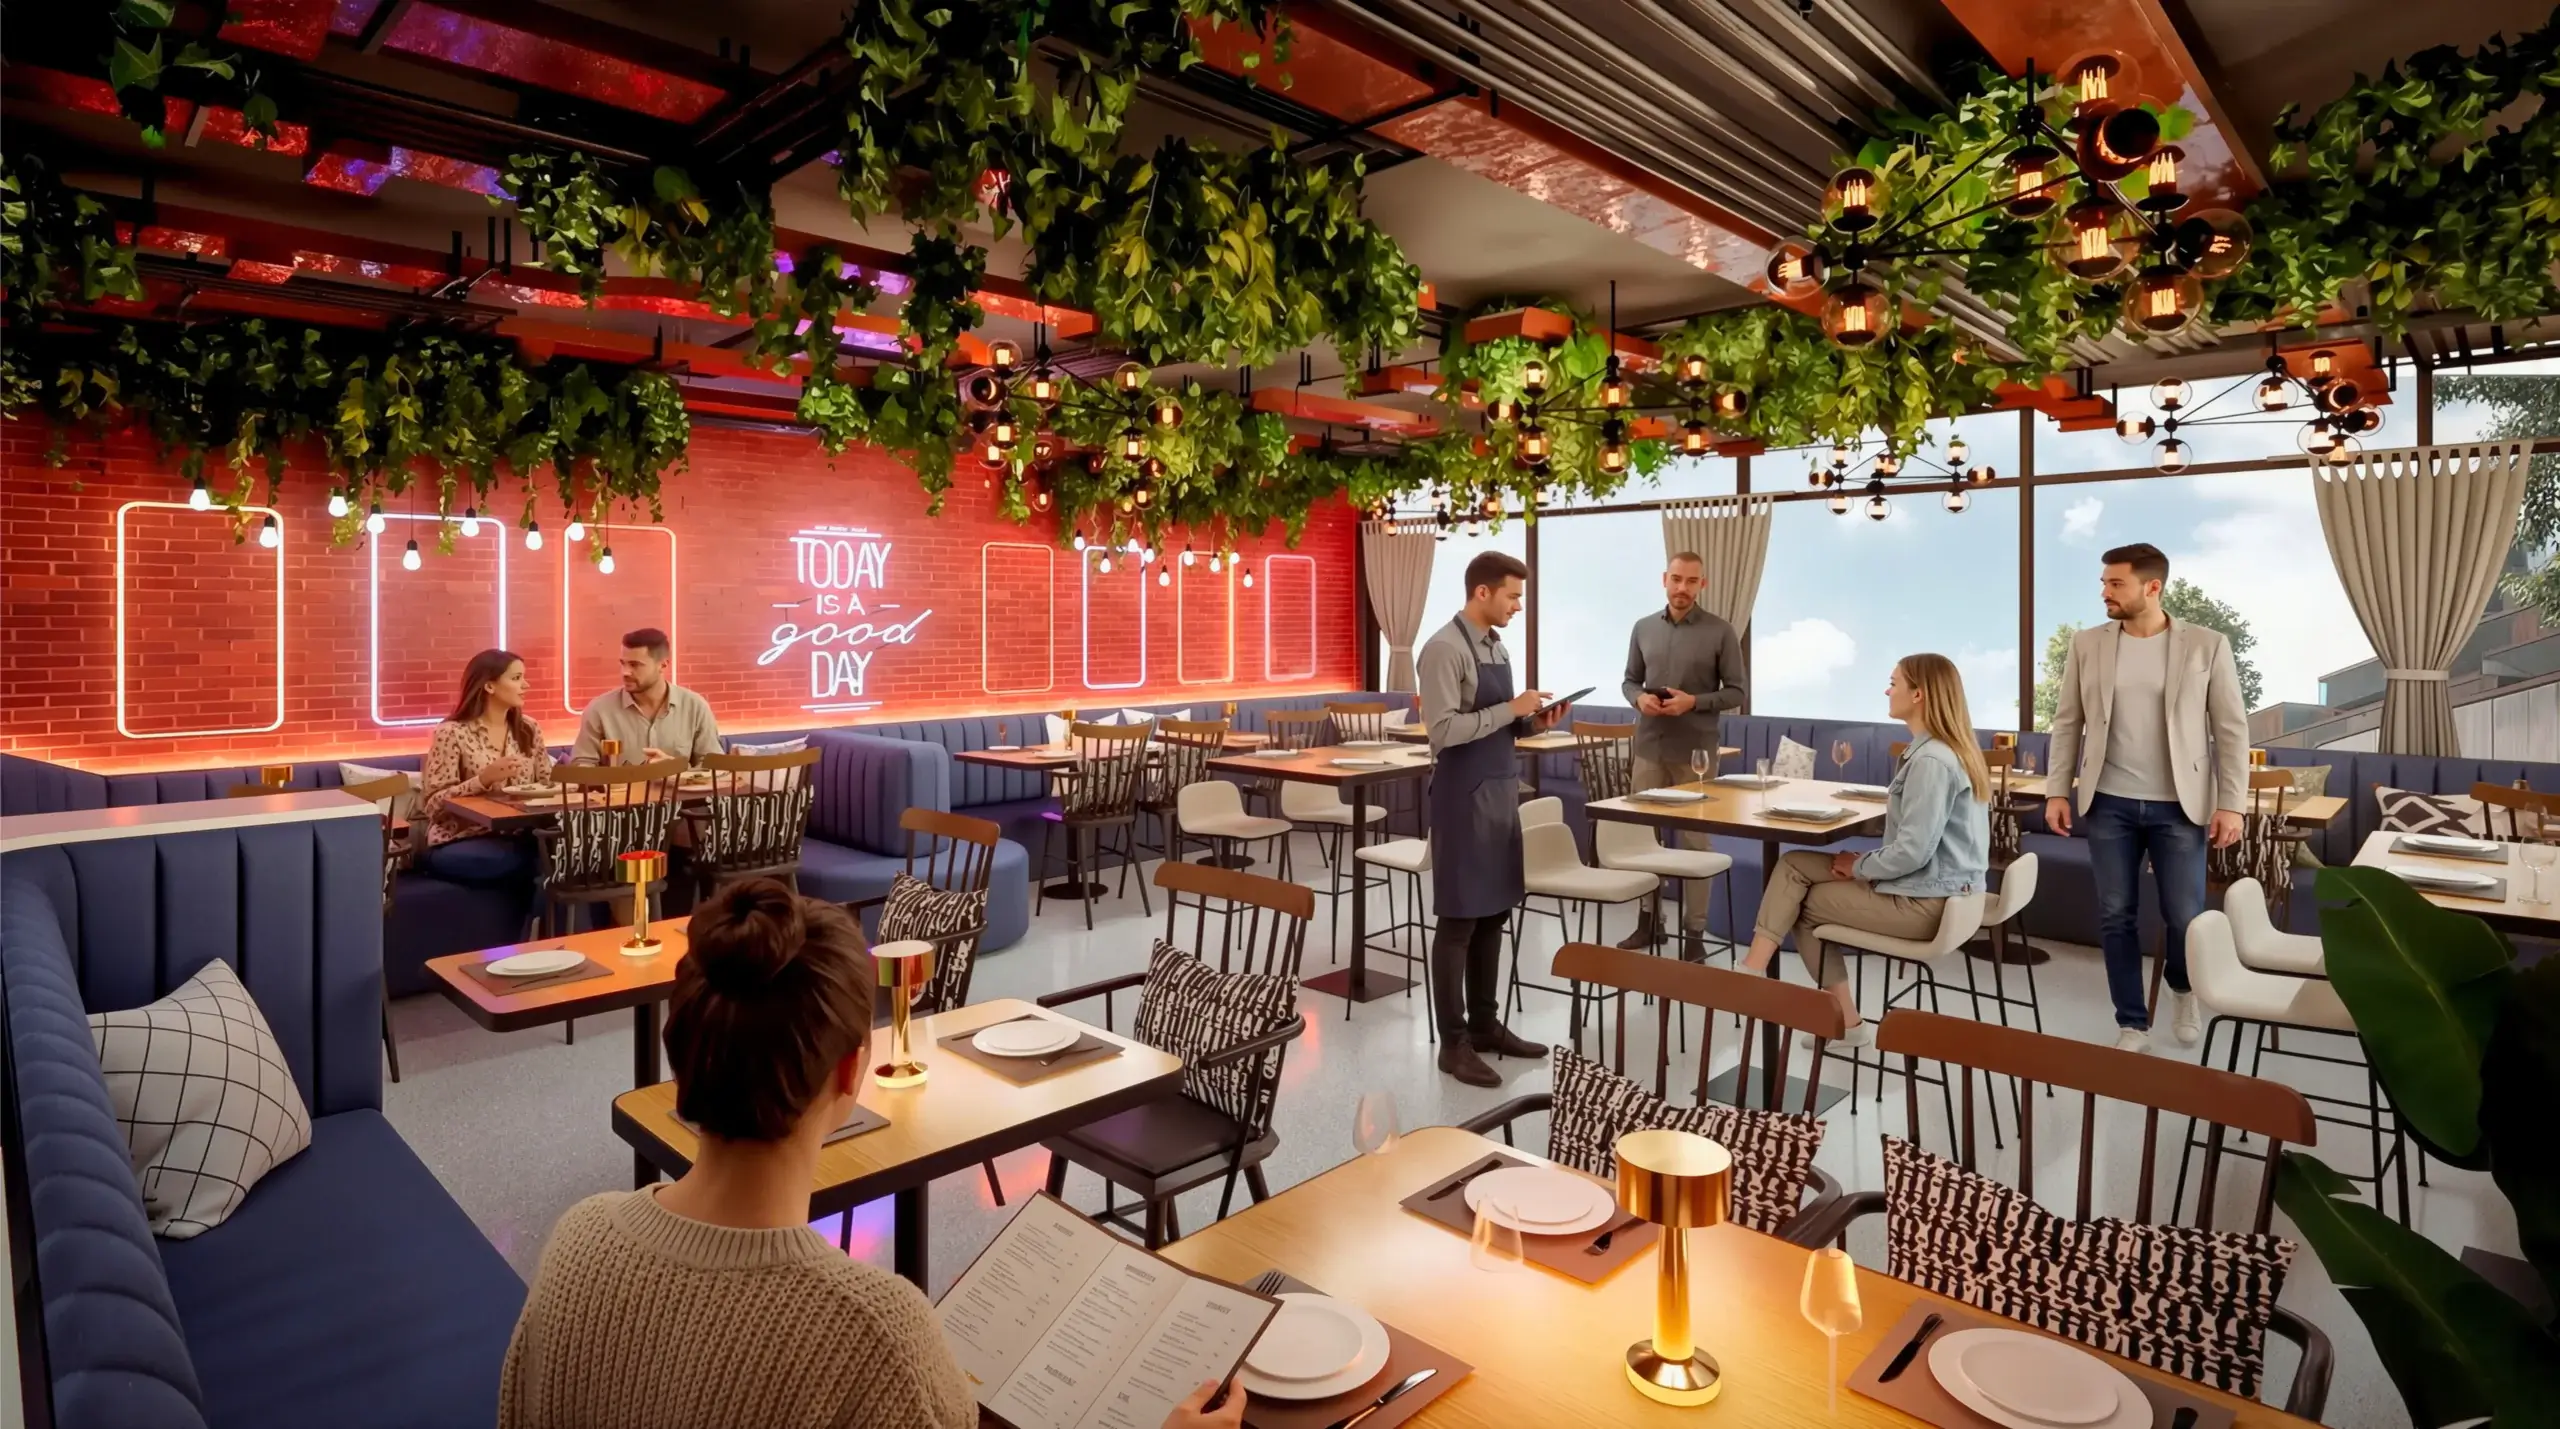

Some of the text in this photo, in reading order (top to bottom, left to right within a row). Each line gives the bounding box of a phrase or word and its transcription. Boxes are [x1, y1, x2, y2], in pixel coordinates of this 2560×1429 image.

[789, 536, 892, 589] TODAY
[816, 593, 866, 616] IS A
[757, 608, 933, 666] good
[811, 650, 873, 698] DAY
